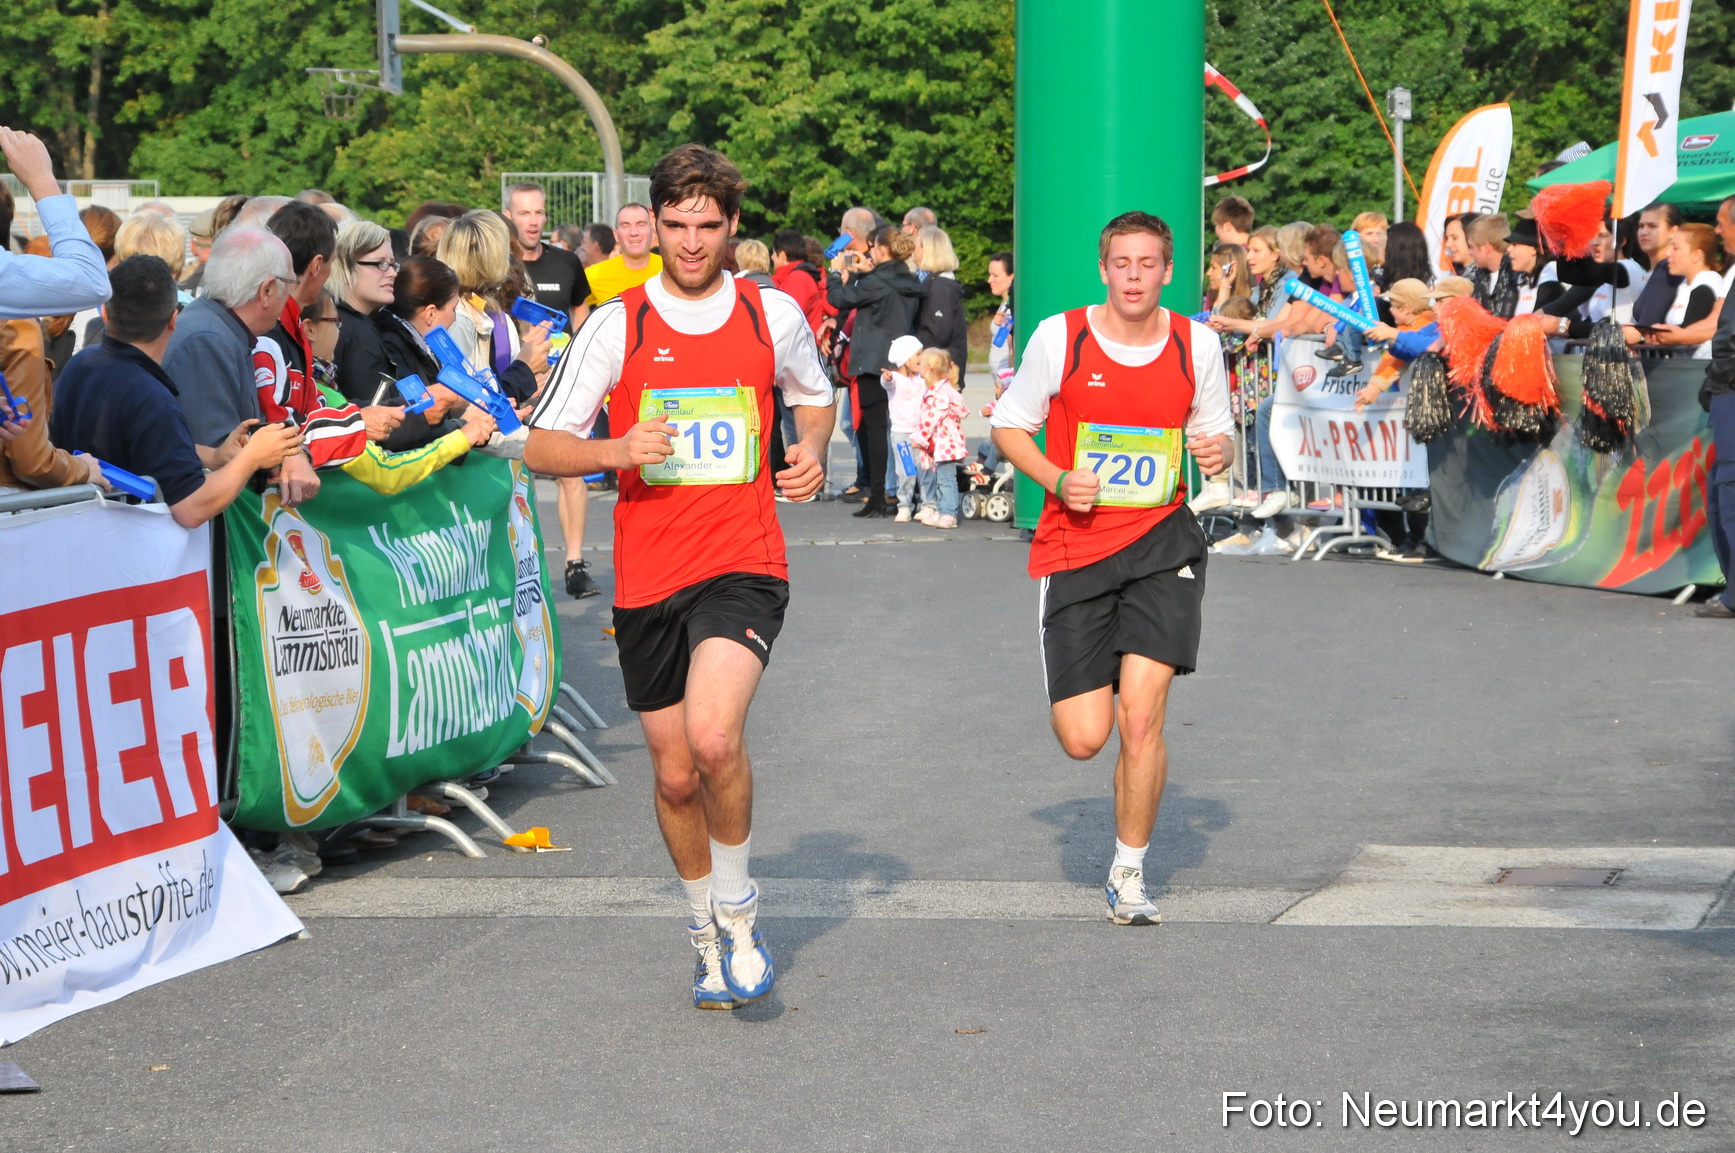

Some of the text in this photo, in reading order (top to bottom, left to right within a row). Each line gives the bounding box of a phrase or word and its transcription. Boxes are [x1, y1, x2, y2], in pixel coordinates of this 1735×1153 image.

[537, 283, 560, 291] THULE
[663, 461, 712, 471] Alexander
[1087, 452, 1156, 487] 720
[1100, 485, 1126, 494] Marcel
[368, 501, 491, 609] Neumarkter
[271, 627, 359, 677] Lammsbräu
[379, 597, 518, 759] Lammsbräu
[0, 606, 218, 876] EIER
